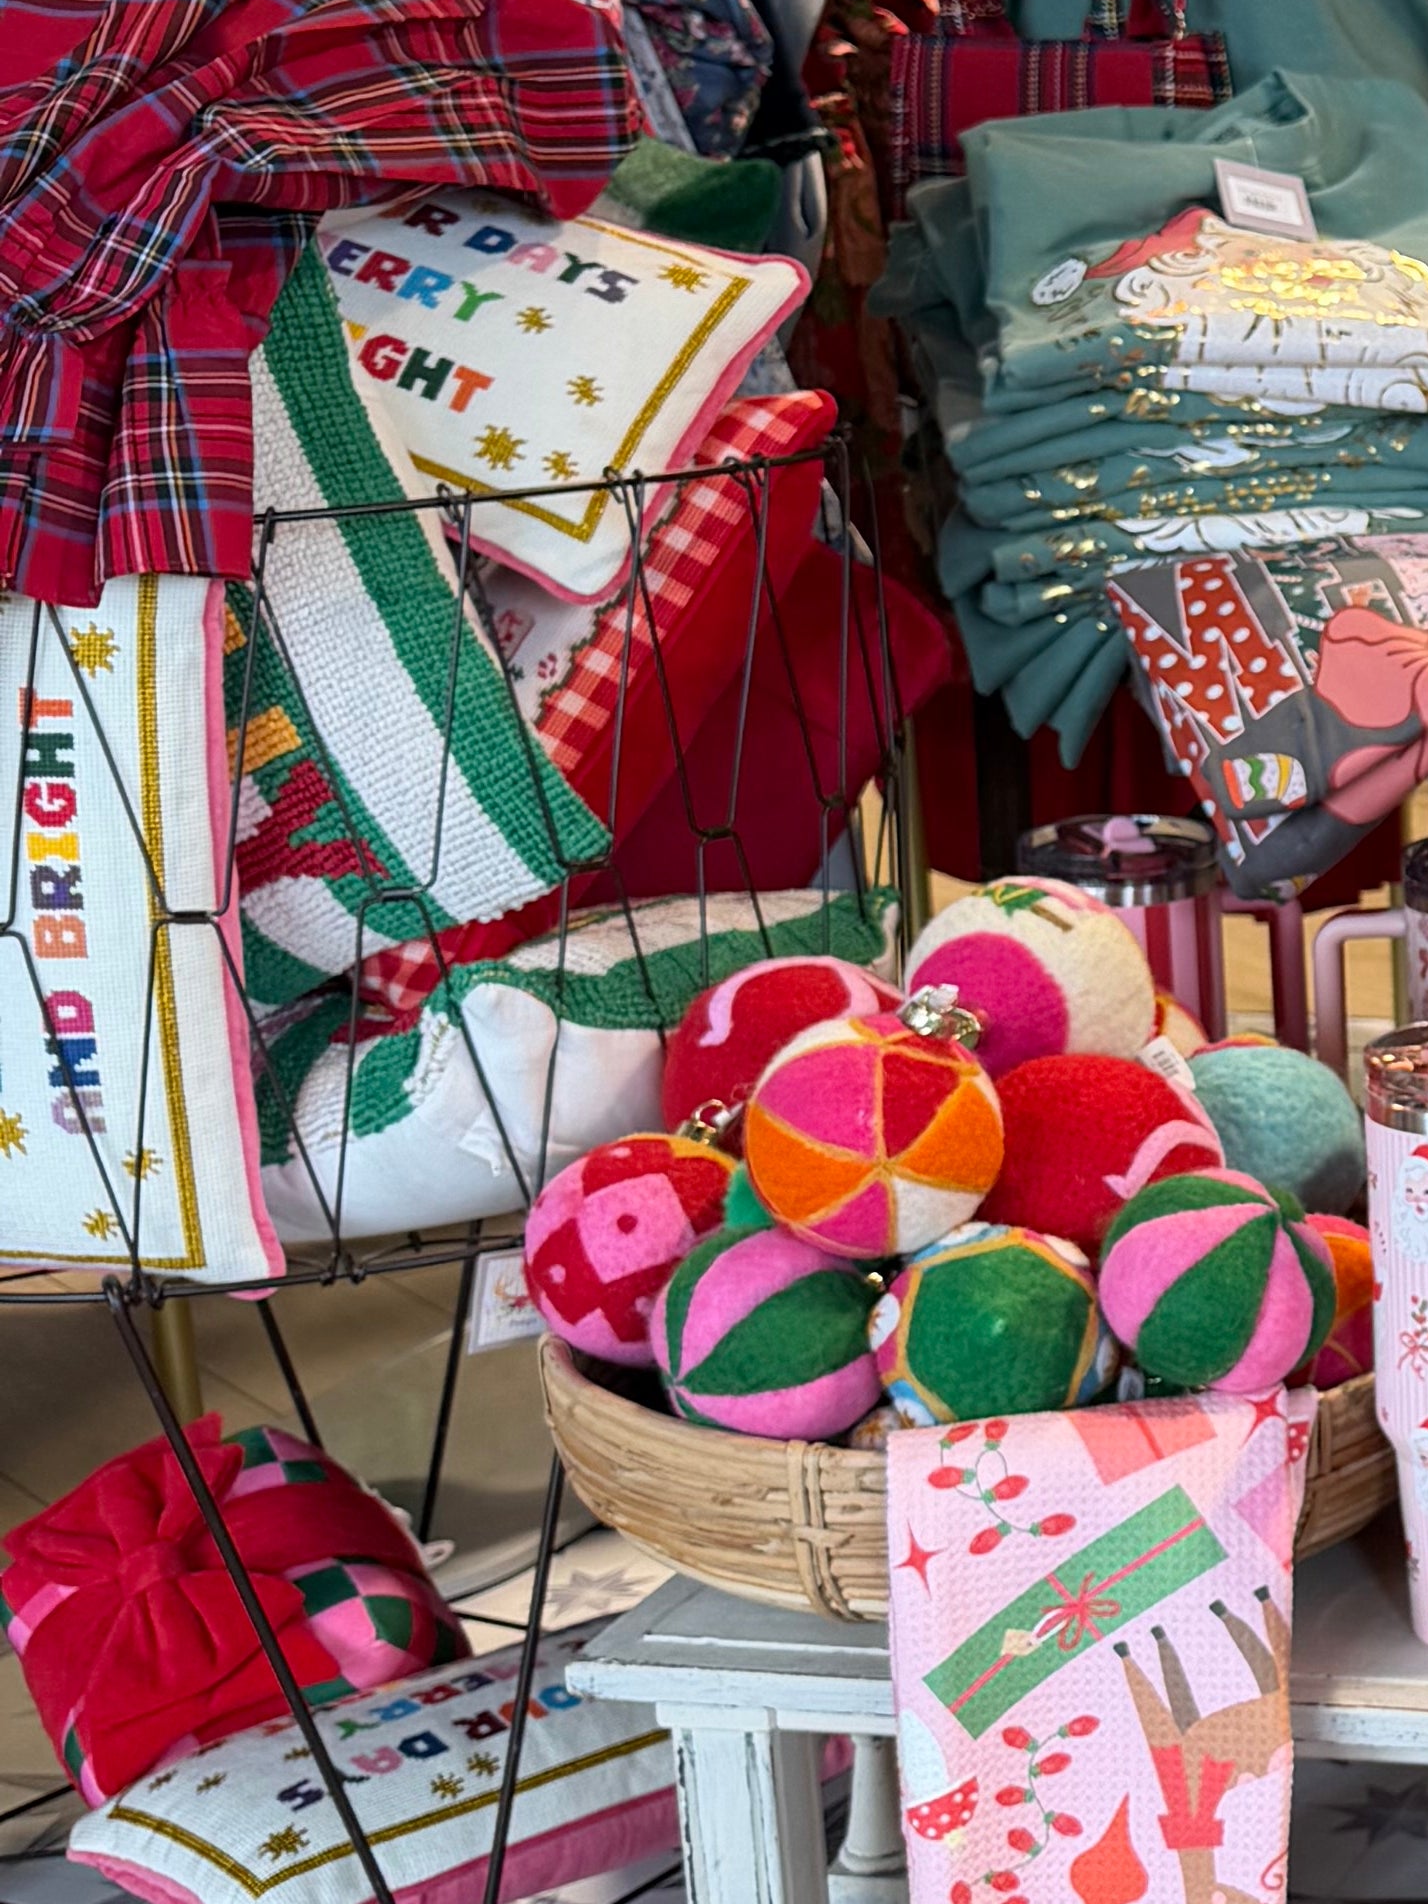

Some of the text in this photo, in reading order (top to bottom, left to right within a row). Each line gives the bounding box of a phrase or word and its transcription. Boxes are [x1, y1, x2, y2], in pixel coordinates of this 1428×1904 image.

[317, 234, 506, 323] ERRY
[463, 225, 640, 304] DAYS
[18, 686, 107, 1136] AND BRIGHT
